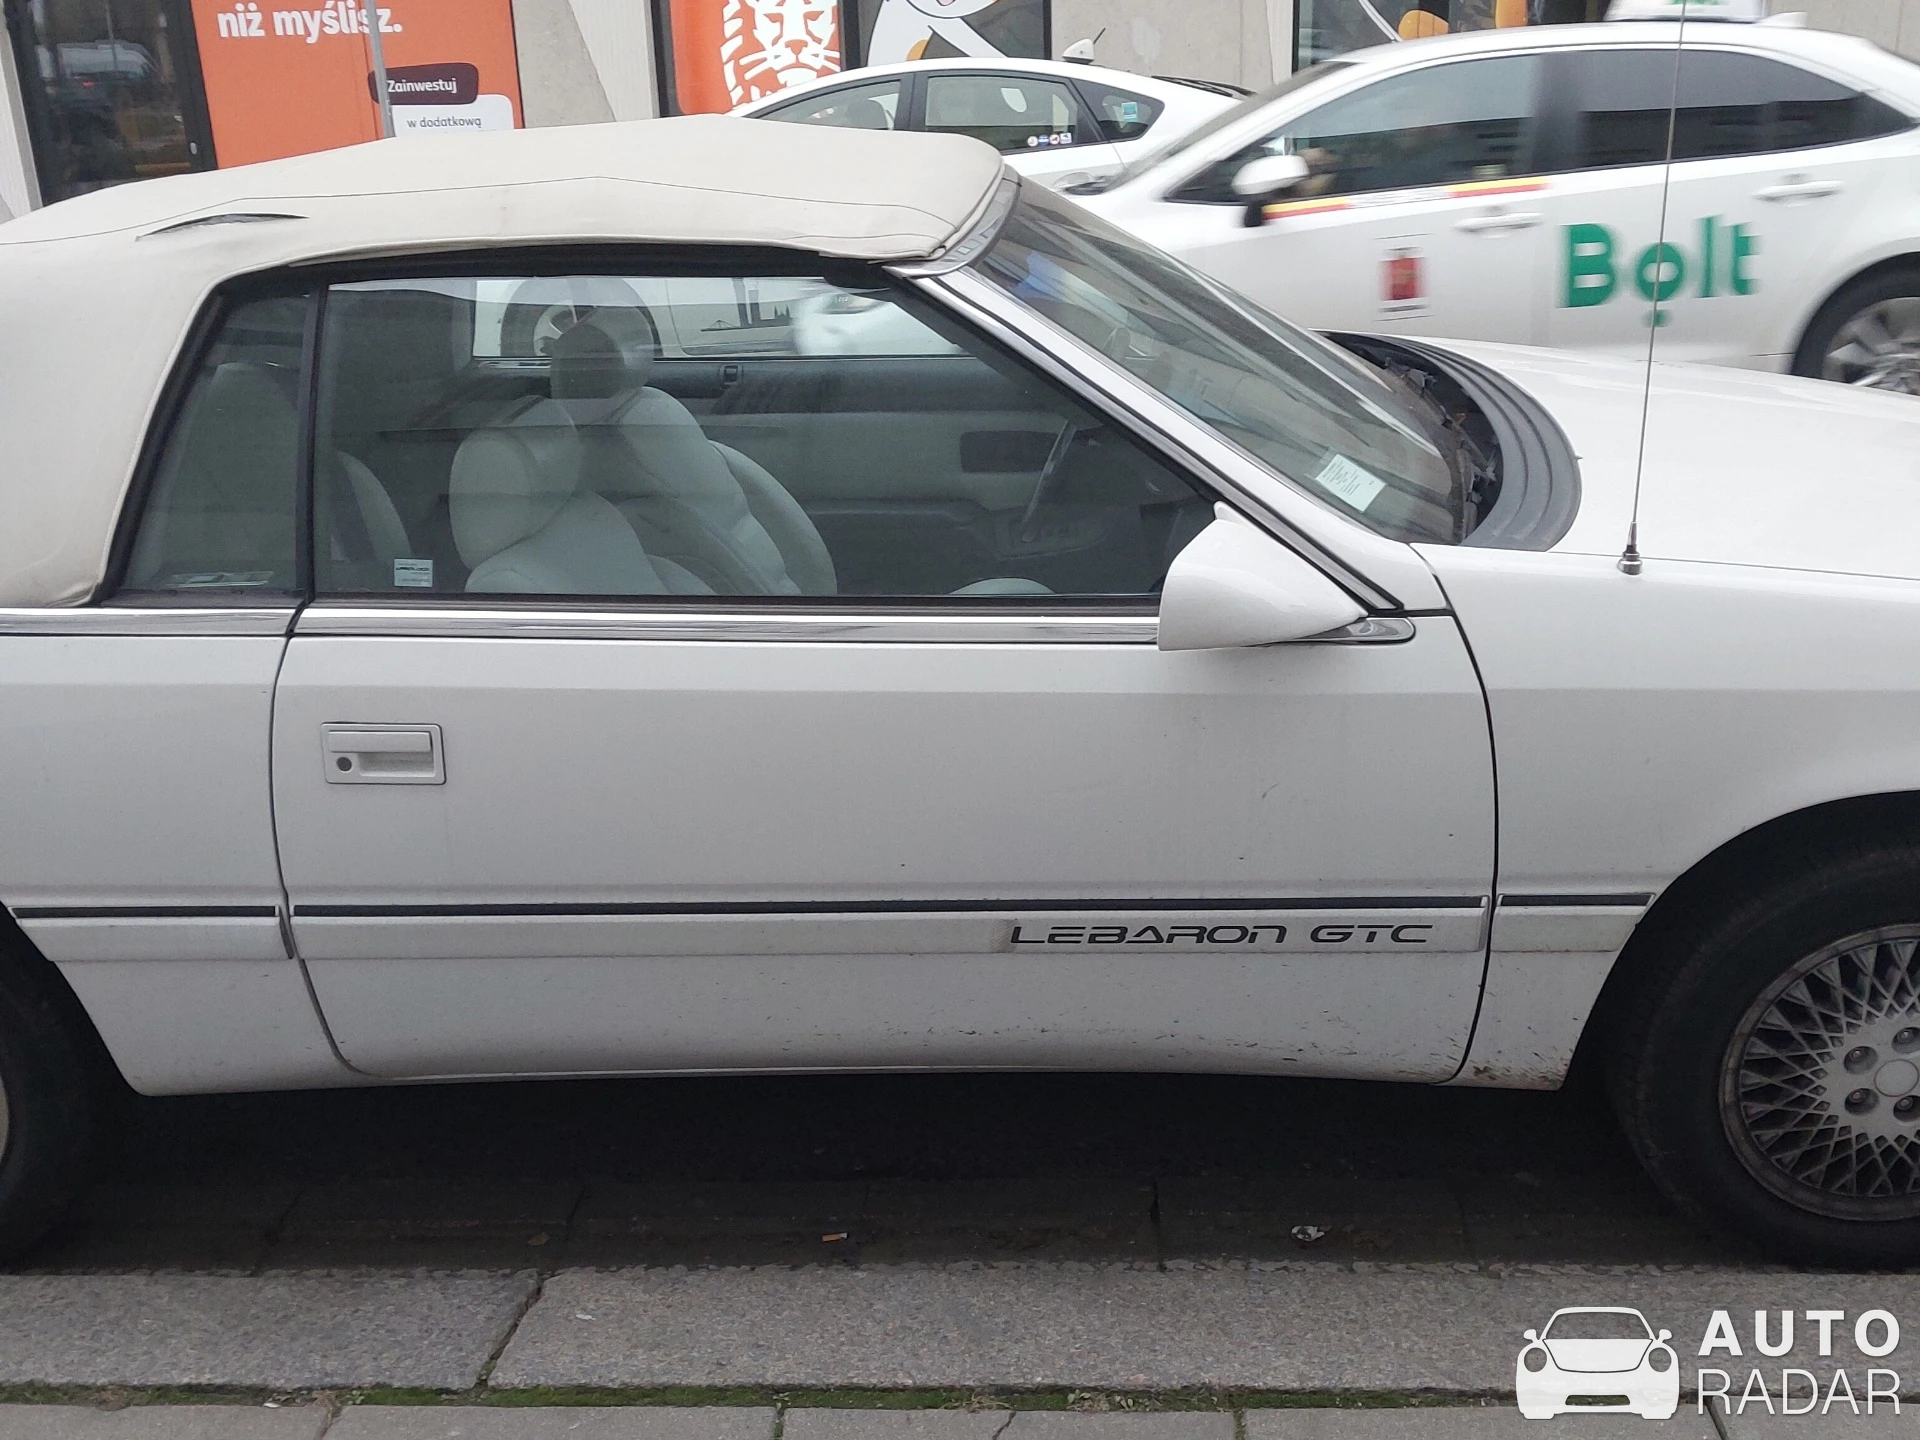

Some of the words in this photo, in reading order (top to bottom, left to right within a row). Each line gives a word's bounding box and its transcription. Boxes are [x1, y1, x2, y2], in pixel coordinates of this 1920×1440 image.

[217, 2, 266, 38] niż
[272, 0, 403, 44] myślisz.
[387, 78, 457, 94] Zainwestuj
[406, 119, 417, 128] w
[420, 116, 482, 129] dodatkową
[1557, 216, 1760, 309] Bolt
[1010, 925, 1287, 944] LEBARON
[1310, 924, 1433, 944] GTC
